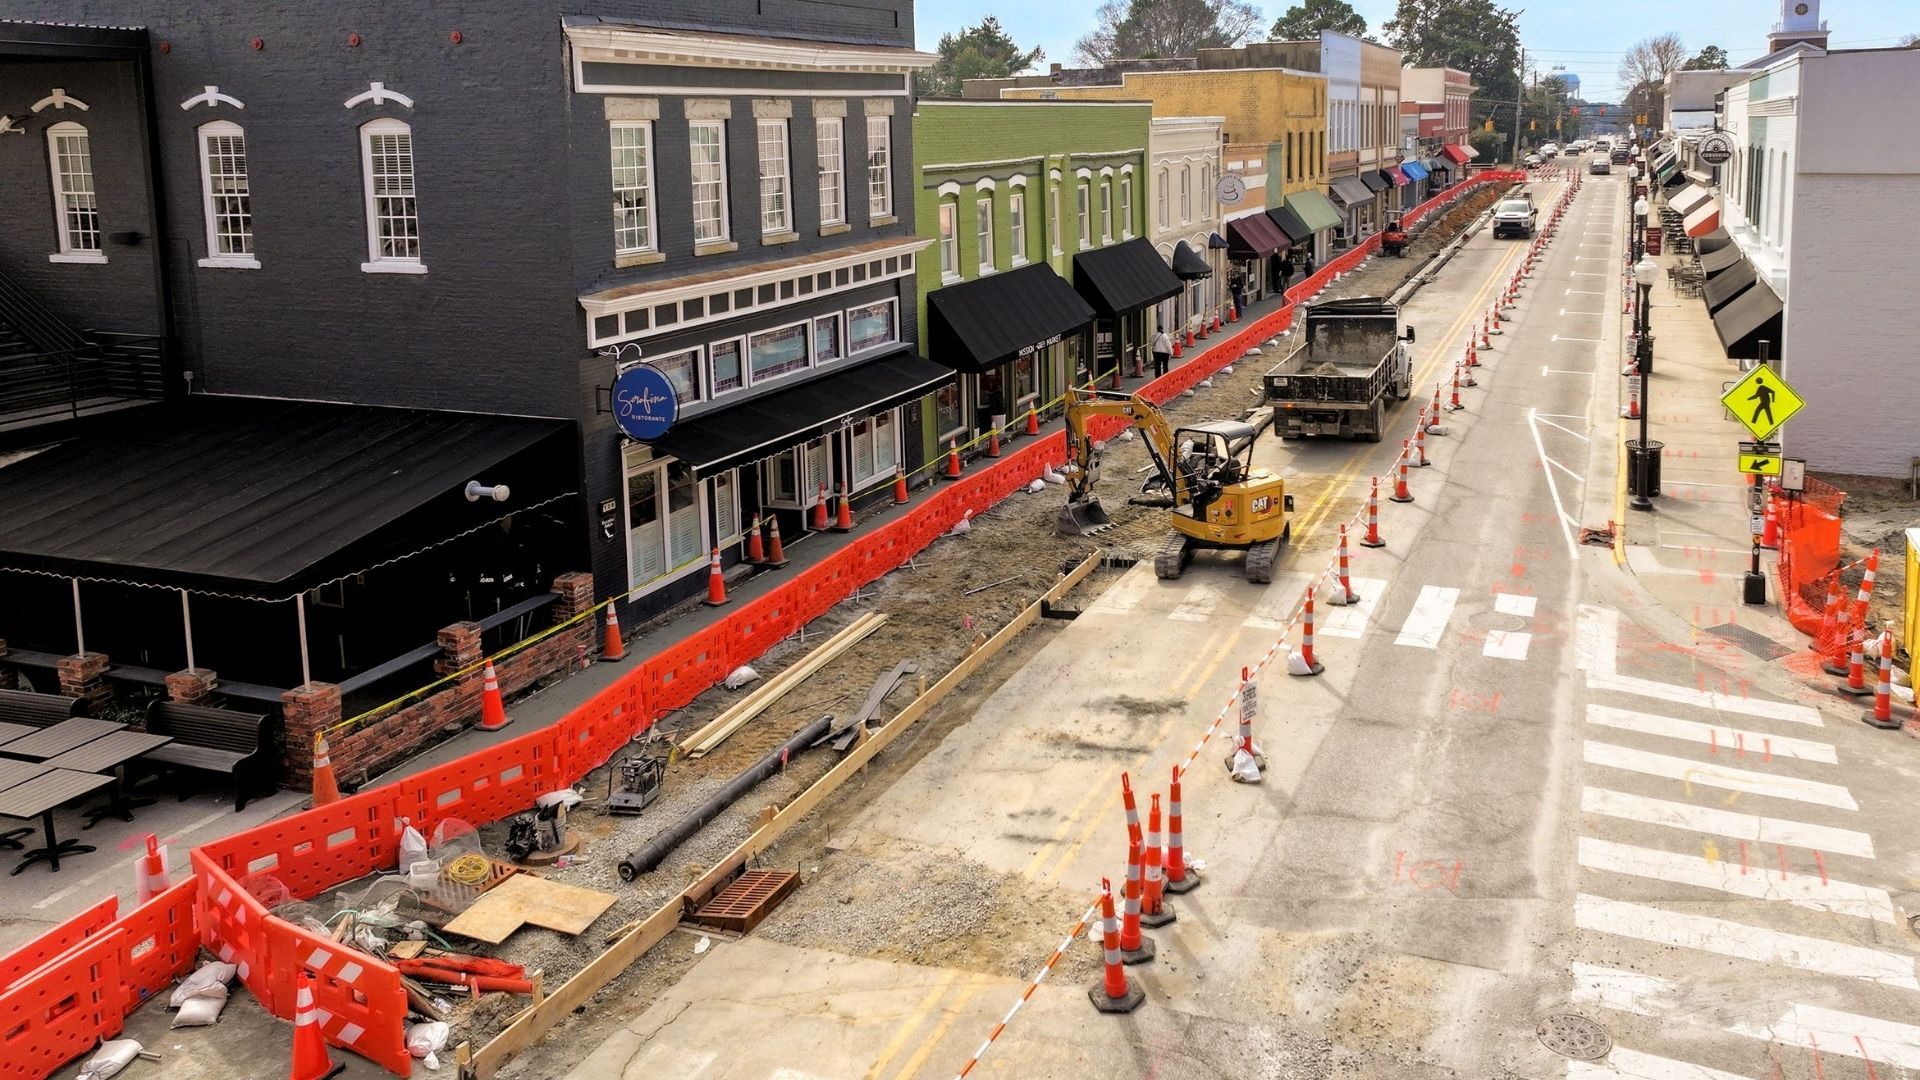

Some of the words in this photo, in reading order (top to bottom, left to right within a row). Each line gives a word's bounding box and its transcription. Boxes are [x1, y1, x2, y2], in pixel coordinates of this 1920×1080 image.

[1122, 405, 1132, 415] CAT
[631, 414, 666, 422] RISTORANTE
[1252, 496, 1269, 513] CAT
